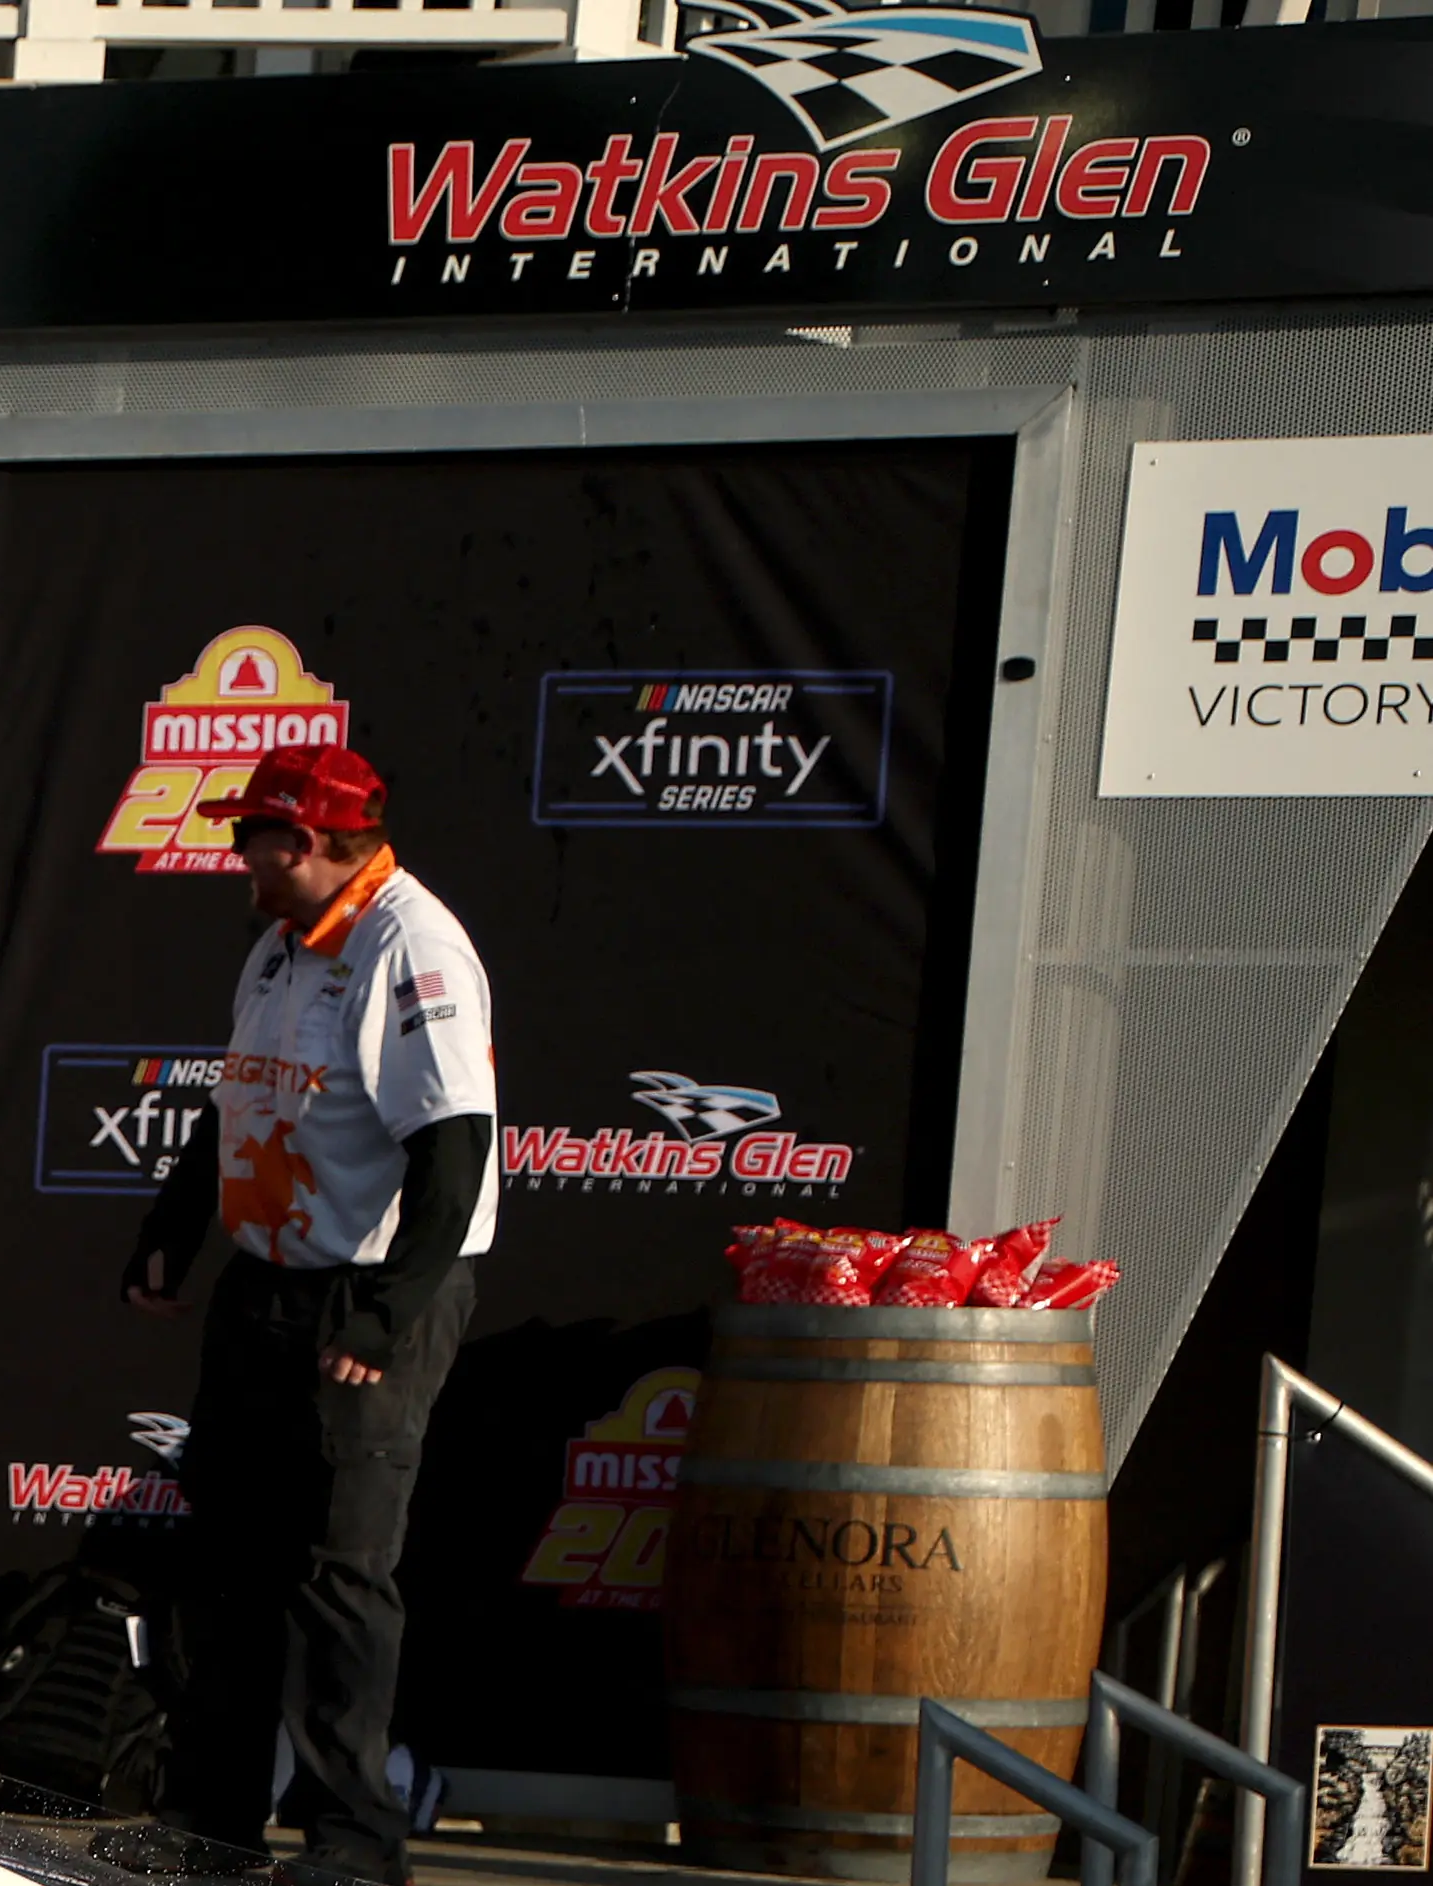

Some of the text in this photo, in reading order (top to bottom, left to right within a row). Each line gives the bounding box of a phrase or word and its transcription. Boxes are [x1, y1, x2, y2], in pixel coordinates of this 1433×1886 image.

[387, 115, 1212, 246] Watkins Glen
[391, 228, 1183, 285] INTERNATIONAL
[675, 683, 794, 712] NASCAR
[1188, 683, 1433, 727] VICTORY
[591, 717, 831, 798] xfinity
[657, 786, 758, 811] SERIES
[502, 1125, 855, 1184] Watkins Glen
[505, 1177, 842, 1200] INTERNATIONAL
